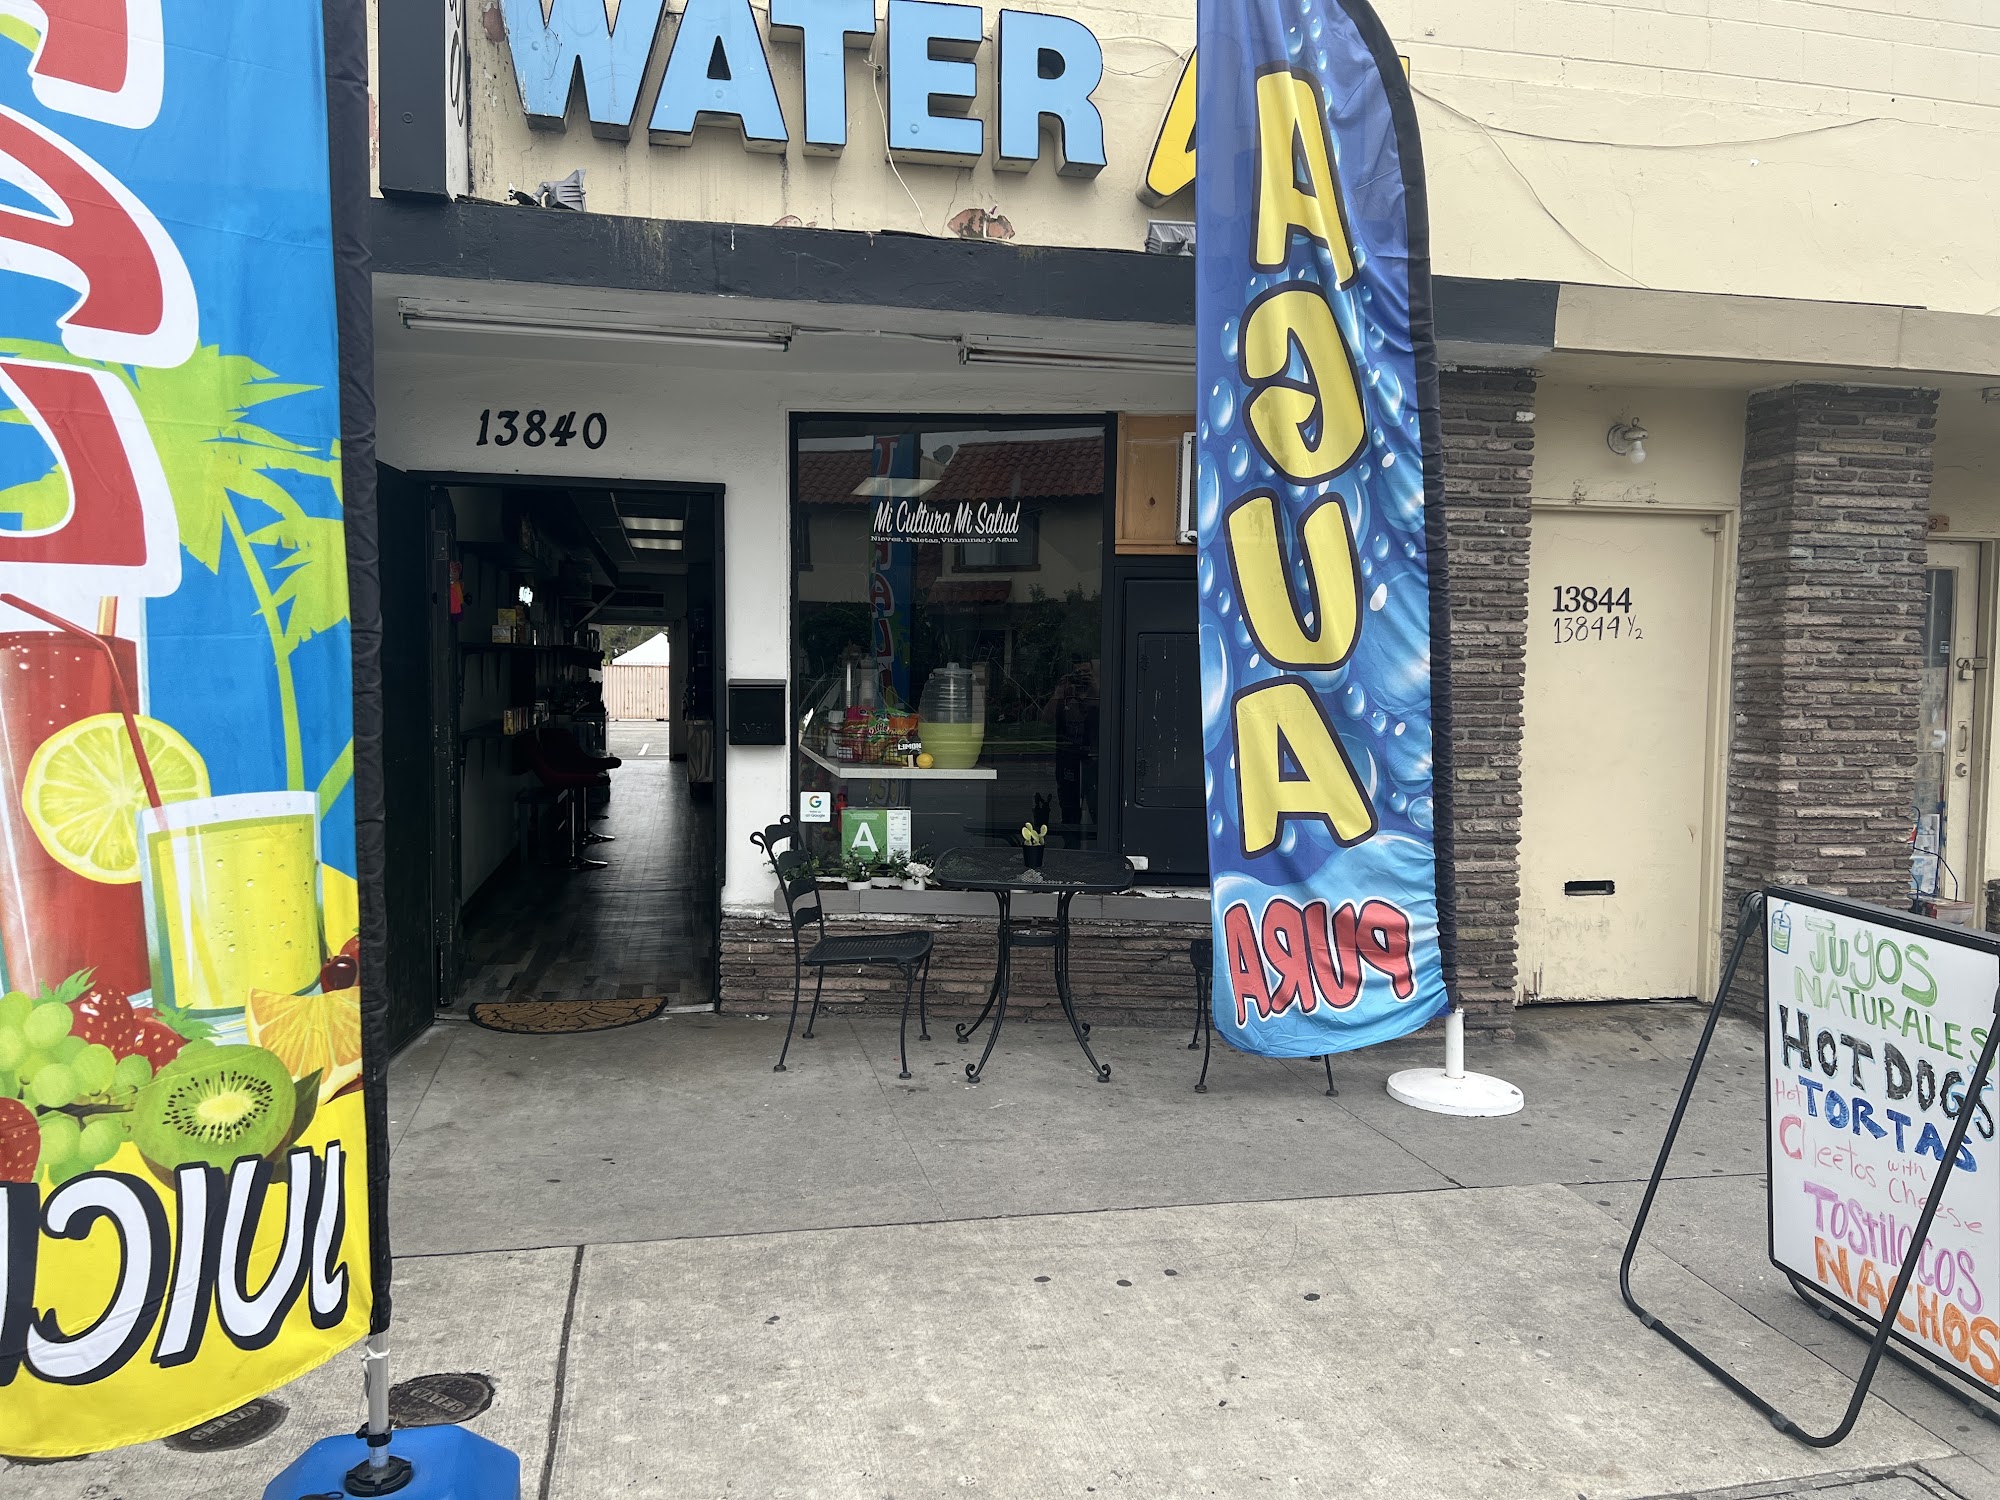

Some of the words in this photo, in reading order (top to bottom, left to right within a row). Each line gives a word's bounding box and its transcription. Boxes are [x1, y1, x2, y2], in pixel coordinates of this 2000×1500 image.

[499, 0, 1107, 172] WATER
[476, 409, 607, 449] 13840
[873, 501, 893, 533] Mi
[896, 500, 952, 535] Cultura
[953, 501, 973, 534] Mi
[975, 501, 1021, 534] Salud
[870, 535, 904, 543] Nieves,
[1552, 585, 1633, 614] 13844
[1554, 616, 1620, 644] 13844
[850, 822, 880, 852] A
[1794, 966, 1996, 1071] NATURALES
[1778, 1003, 1876, 1092] HOT
[1798, 1075, 1978, 1173] TORTAS
[1887, 1159, 1927, 1182] with
[1814, 1236, 2000, 1387] NACHOS
[412, 1388, 465, 1412] WATER
